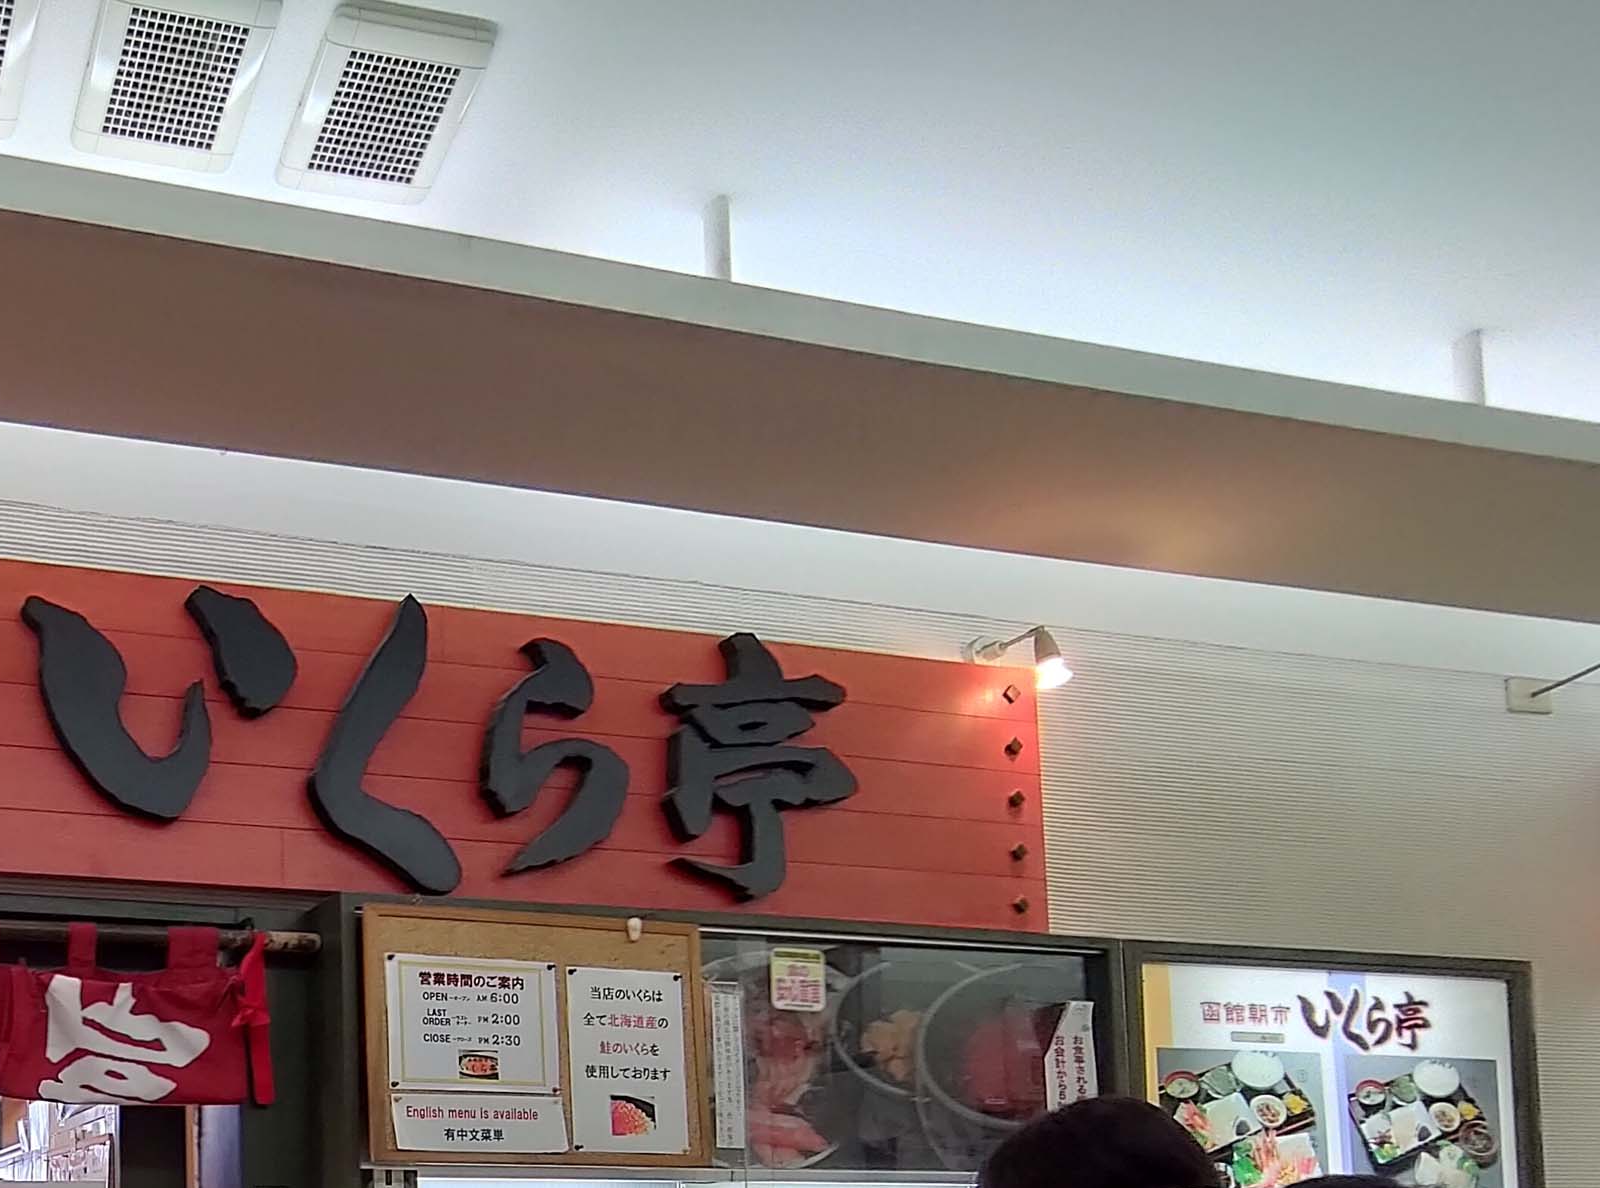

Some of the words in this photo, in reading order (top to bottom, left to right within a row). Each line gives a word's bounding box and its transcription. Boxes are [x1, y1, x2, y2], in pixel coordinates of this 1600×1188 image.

[21, 584, 860, 901] いくら亭
[418, 971, 525, 991] 営業時間のご案内
[422, 991, 448, 1001] OPEN
[490, 992, 519, 1004] 6:00
[590, 985, 664, 1003] 当店のいくらは
[422, 1017, 451, 1026] ORDER
[491, 1013, 520, 1026] 2:00
[426, 1008, 447, 1017] LAST
[583, 1012, 669, 1030] 全て北海道産の
[1296, 987, 1432, 1052] いくら亭
[492, 1034, 521, 1046] 2:30
[599, 1040, 660, 1057] 鮭のいくらを
[585, 1064, 671, 1081] 使用しております
[406, 1105, 444, 1120] English
[448, 1108, 477, 1119] menu
[493, 1108, 539, 1120] available
